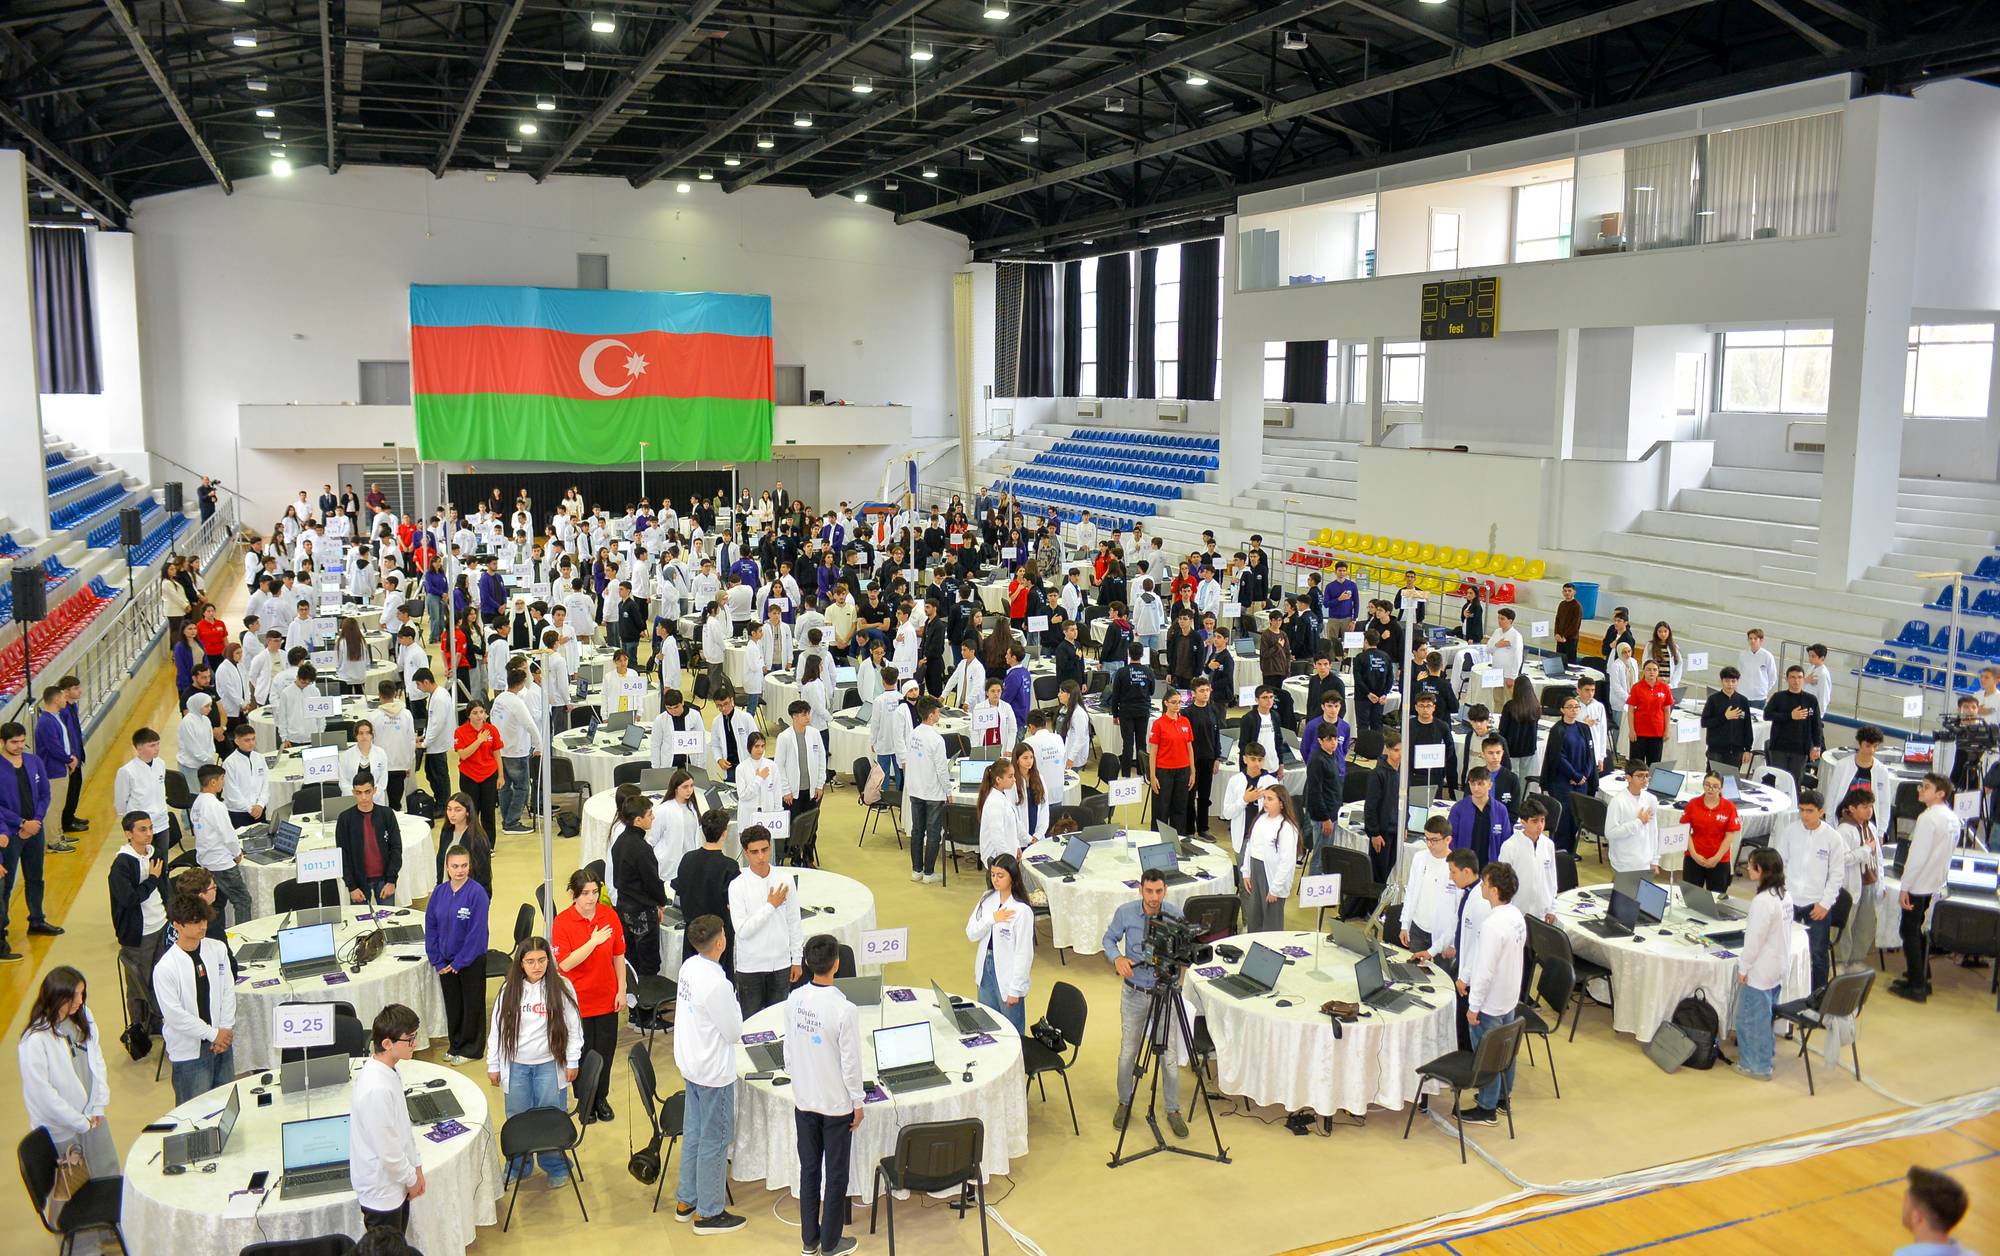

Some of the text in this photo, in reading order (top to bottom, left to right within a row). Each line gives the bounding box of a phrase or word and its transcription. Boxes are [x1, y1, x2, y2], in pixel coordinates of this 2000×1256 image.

[1448, 323, 1465, 334] fest
[308, 702, 329, 712] 9_46
[677, 738, 697, 747] 9_41
[309, 764, 333, 775] 9_42
[1115, 786, 1137, 798] 9_35
[303, 860, 336, 871] 1011_11
[1306, 885, 1332, 897] 9_34
[867, 939, 900, 954] 9_26
[283, 1018, 323, 1034] 9_25
